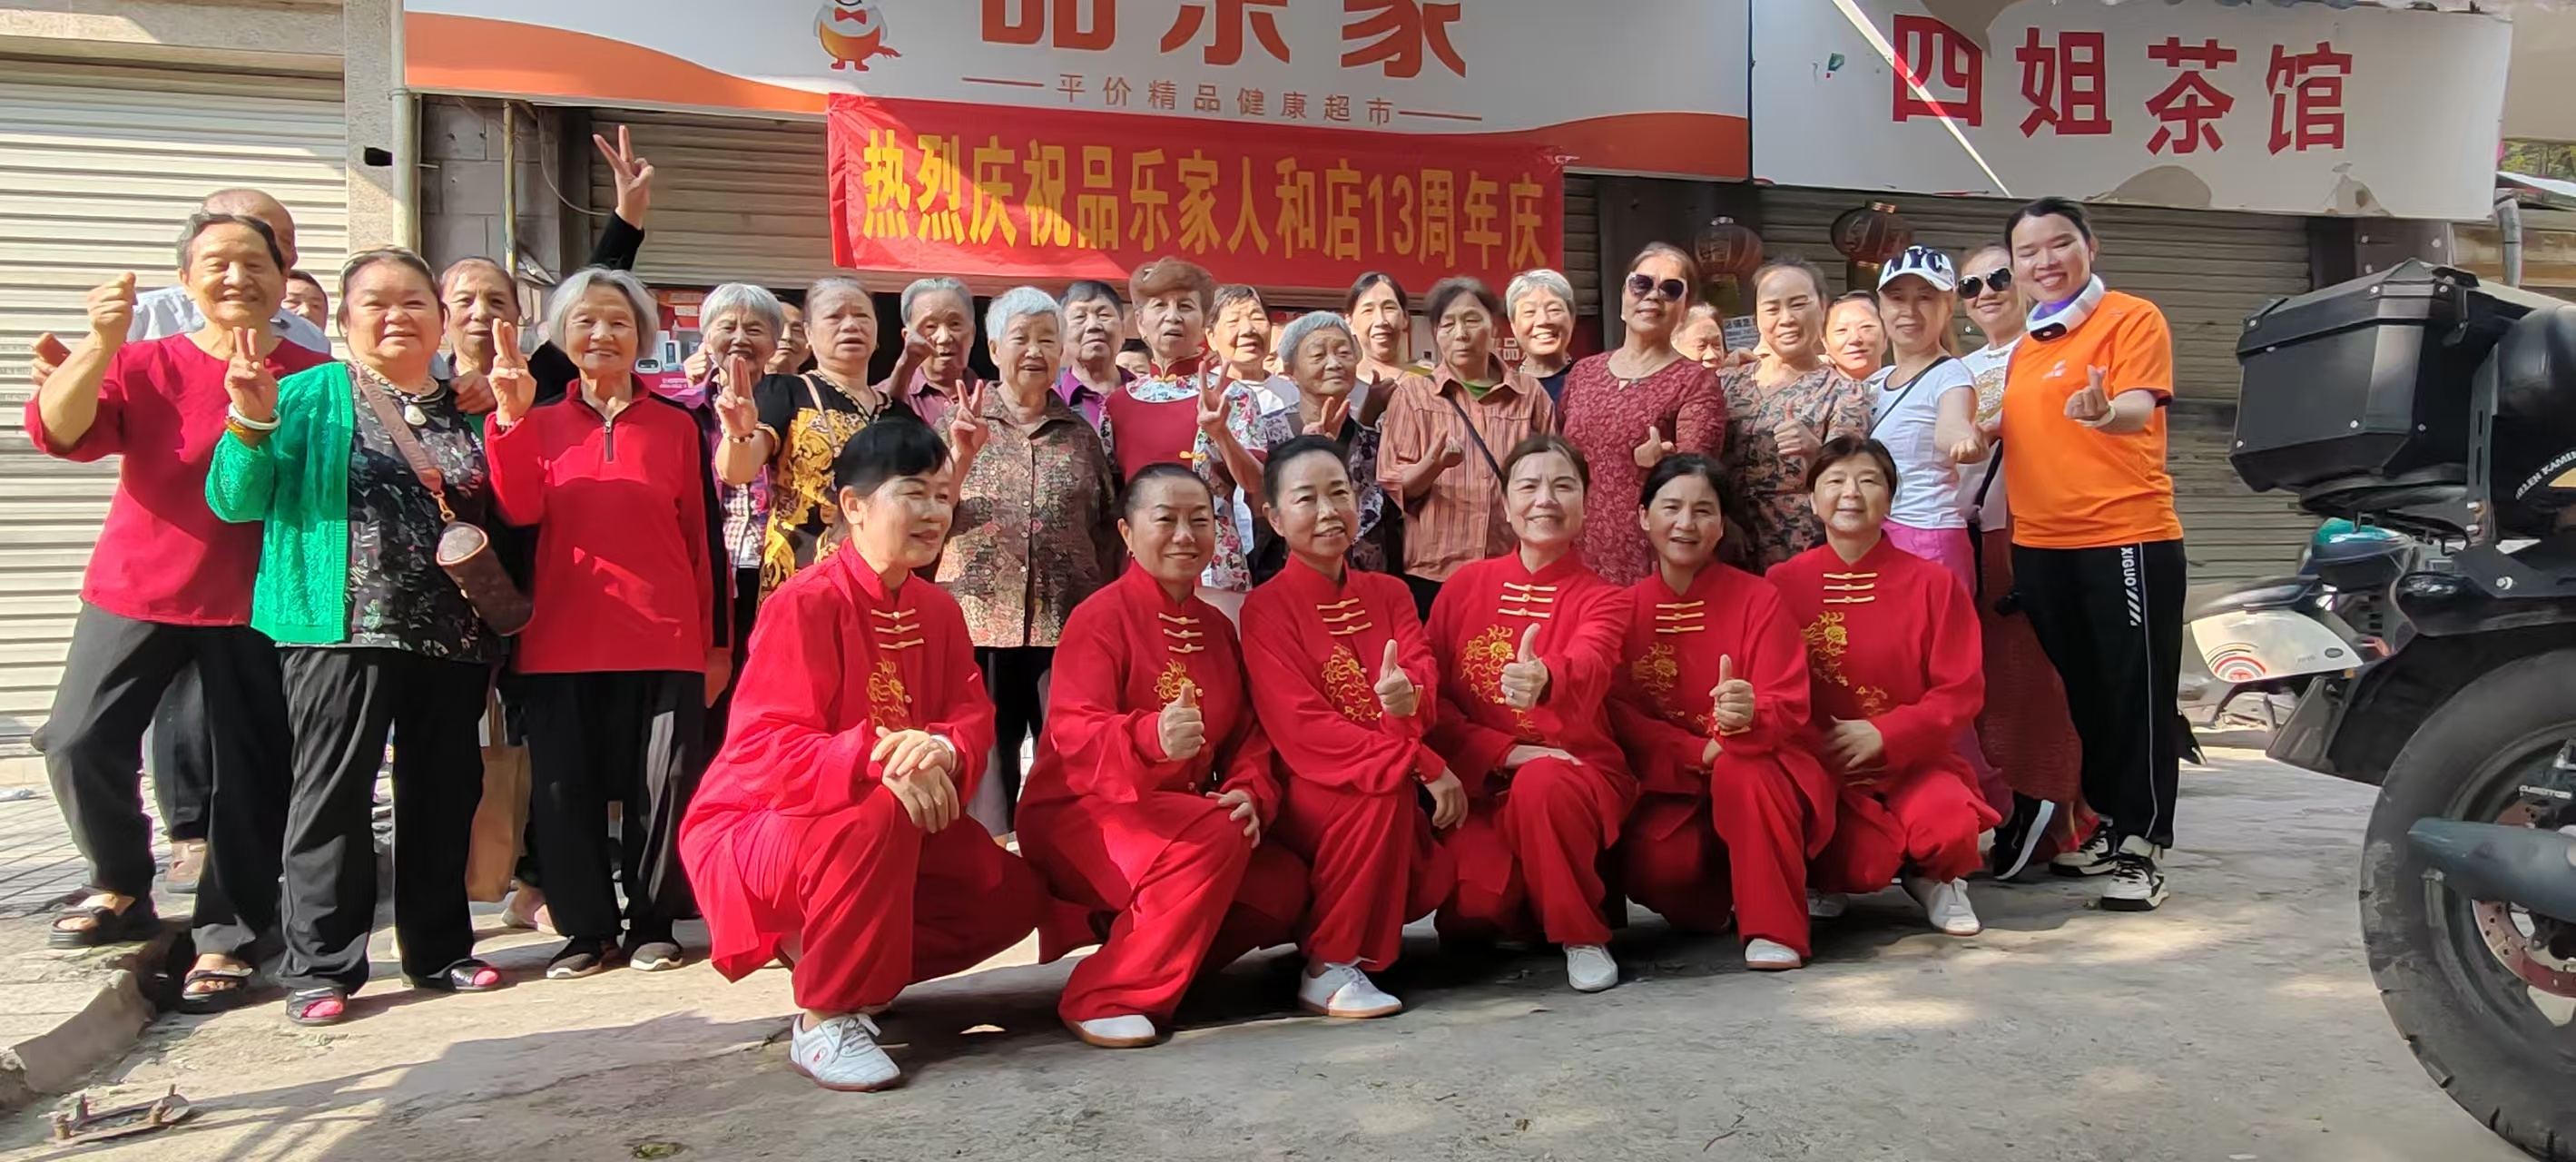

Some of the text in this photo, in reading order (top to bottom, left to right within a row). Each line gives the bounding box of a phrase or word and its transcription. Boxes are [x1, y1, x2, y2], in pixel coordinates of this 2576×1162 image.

[1057, 73, 1394, 127] 平价精品健康超市
[1892, 14, 2353, 156] 四姐茶馆
[862, 128, 1548, 271] 热烈庆祝品乐家人和店13周年庆
[1886, 243, 1944, 277] NYC
